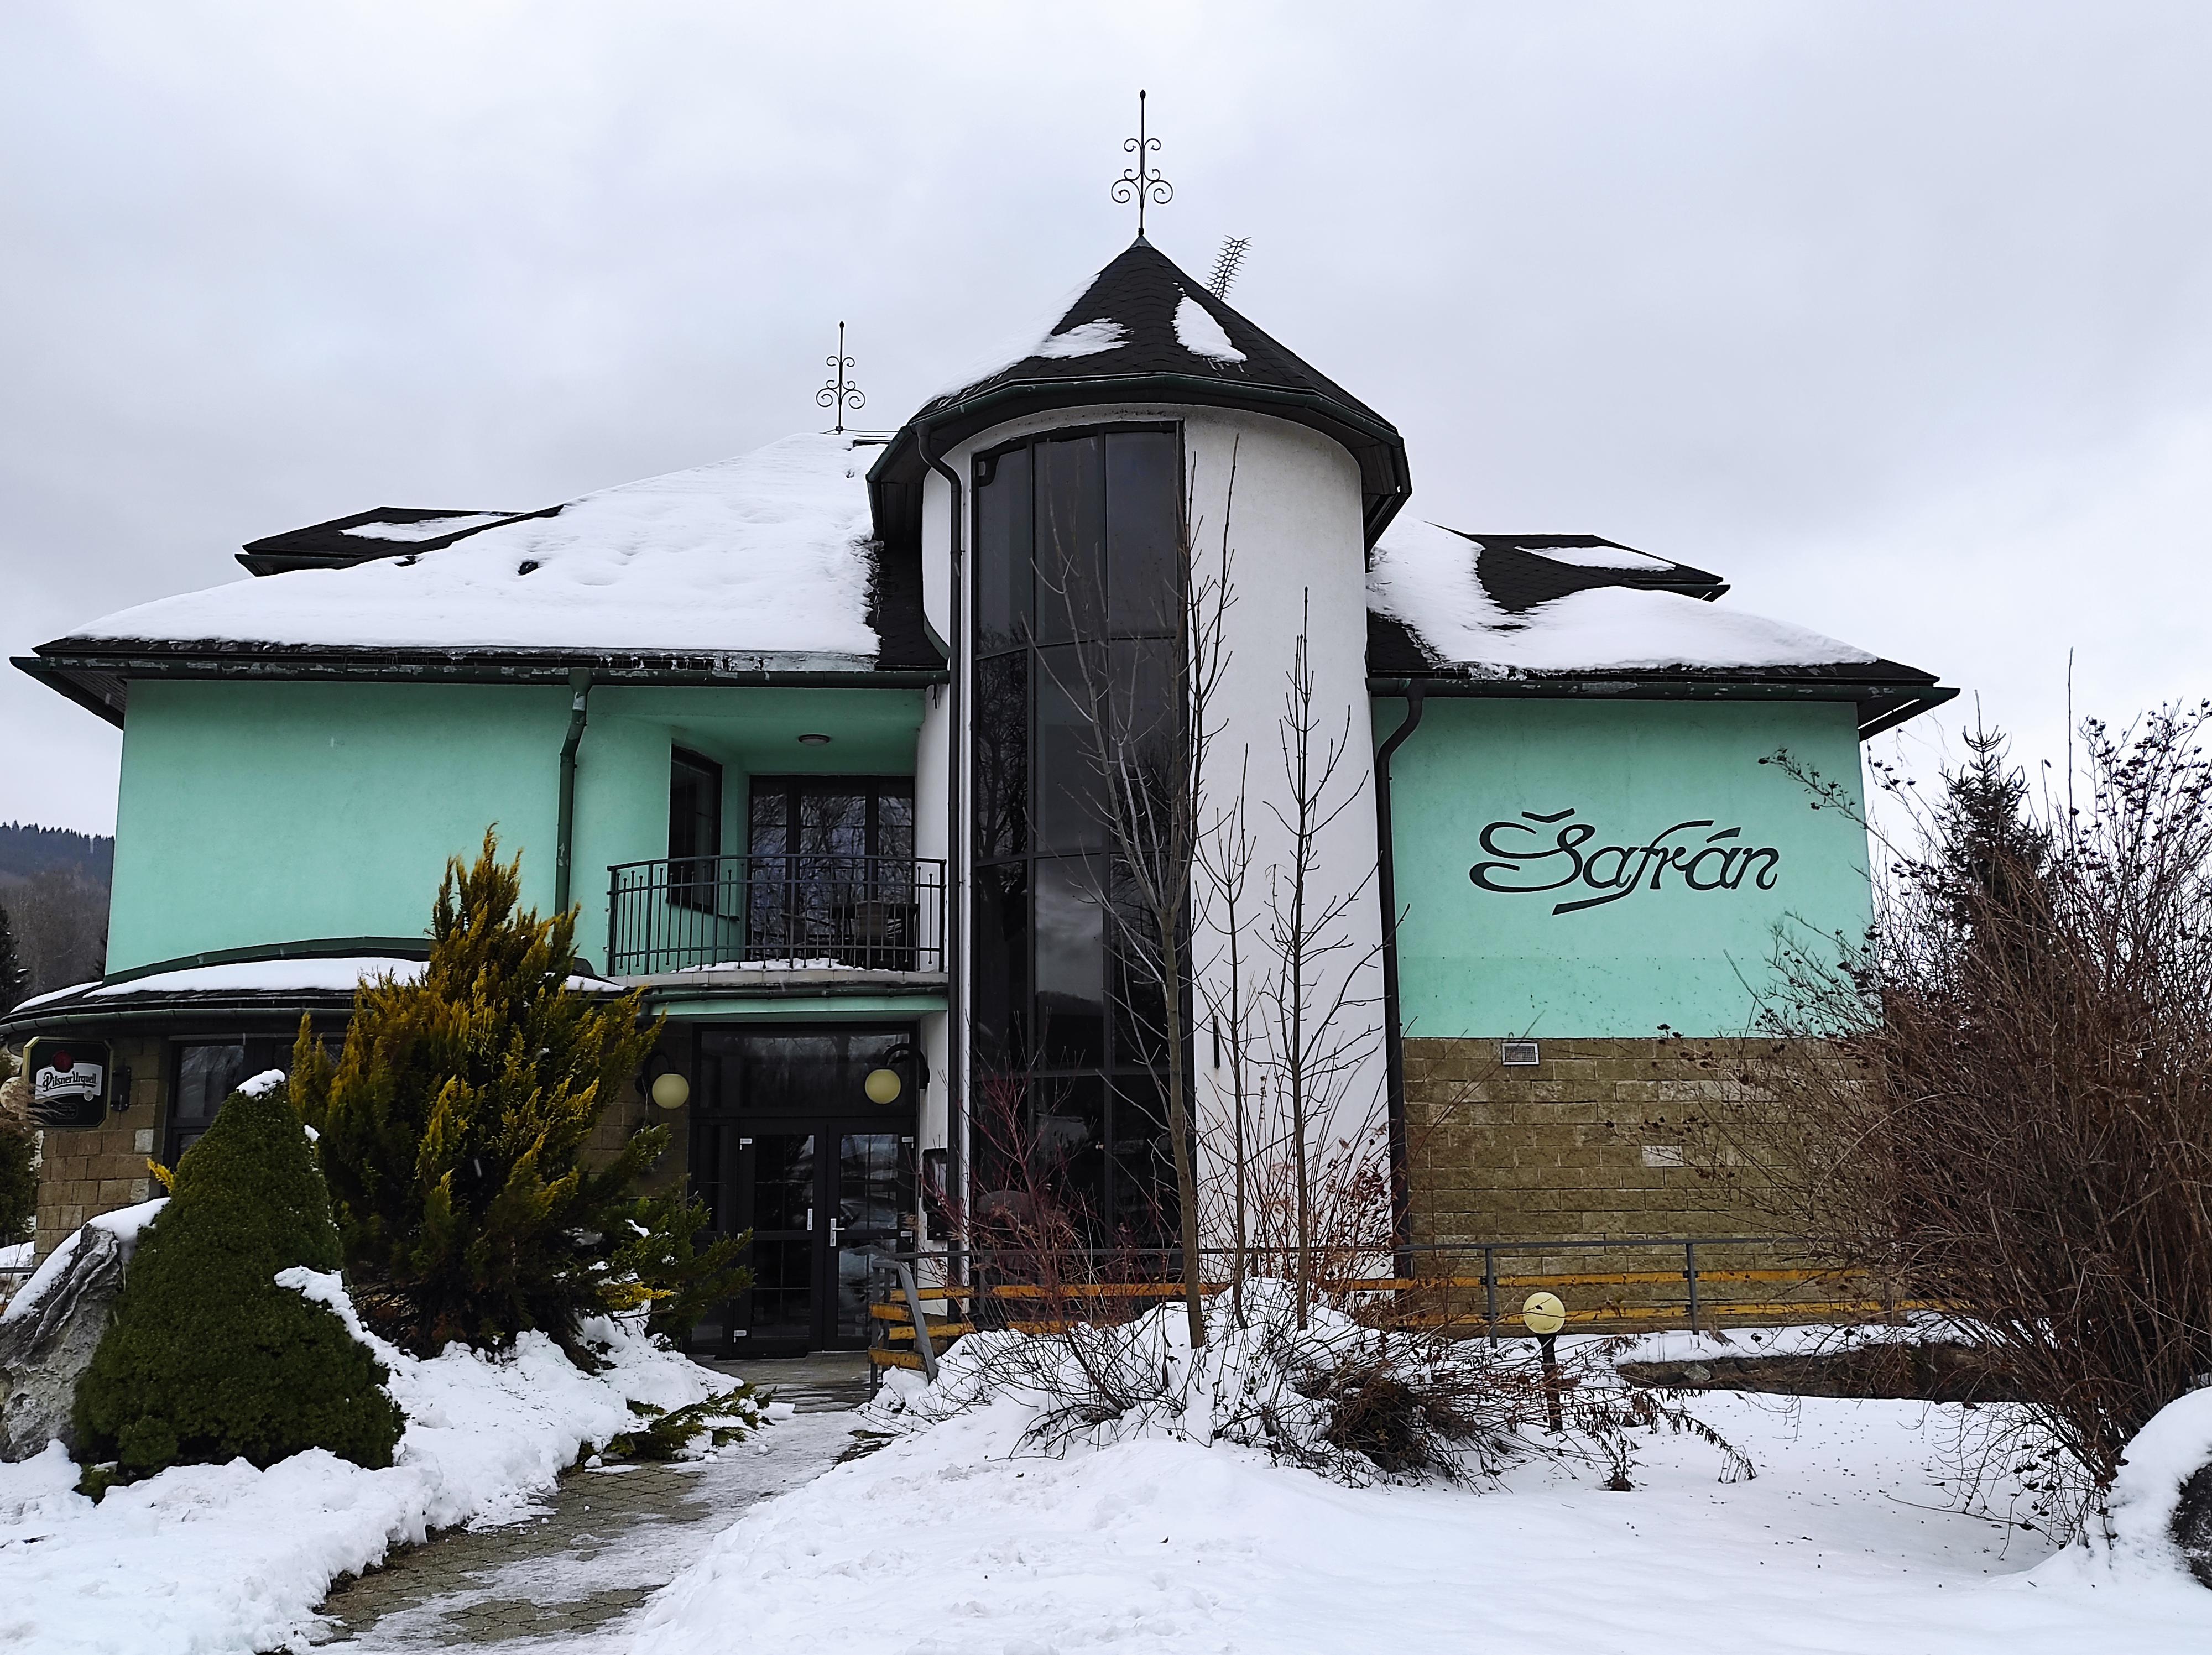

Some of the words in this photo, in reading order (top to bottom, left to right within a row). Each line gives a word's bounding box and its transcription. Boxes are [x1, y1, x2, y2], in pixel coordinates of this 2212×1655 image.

[1469, 807, 1780, 916] Šafrán
[42, 1071, 73, 1092] Pilsner
[72, 1071, 96, 1088] Urquell
